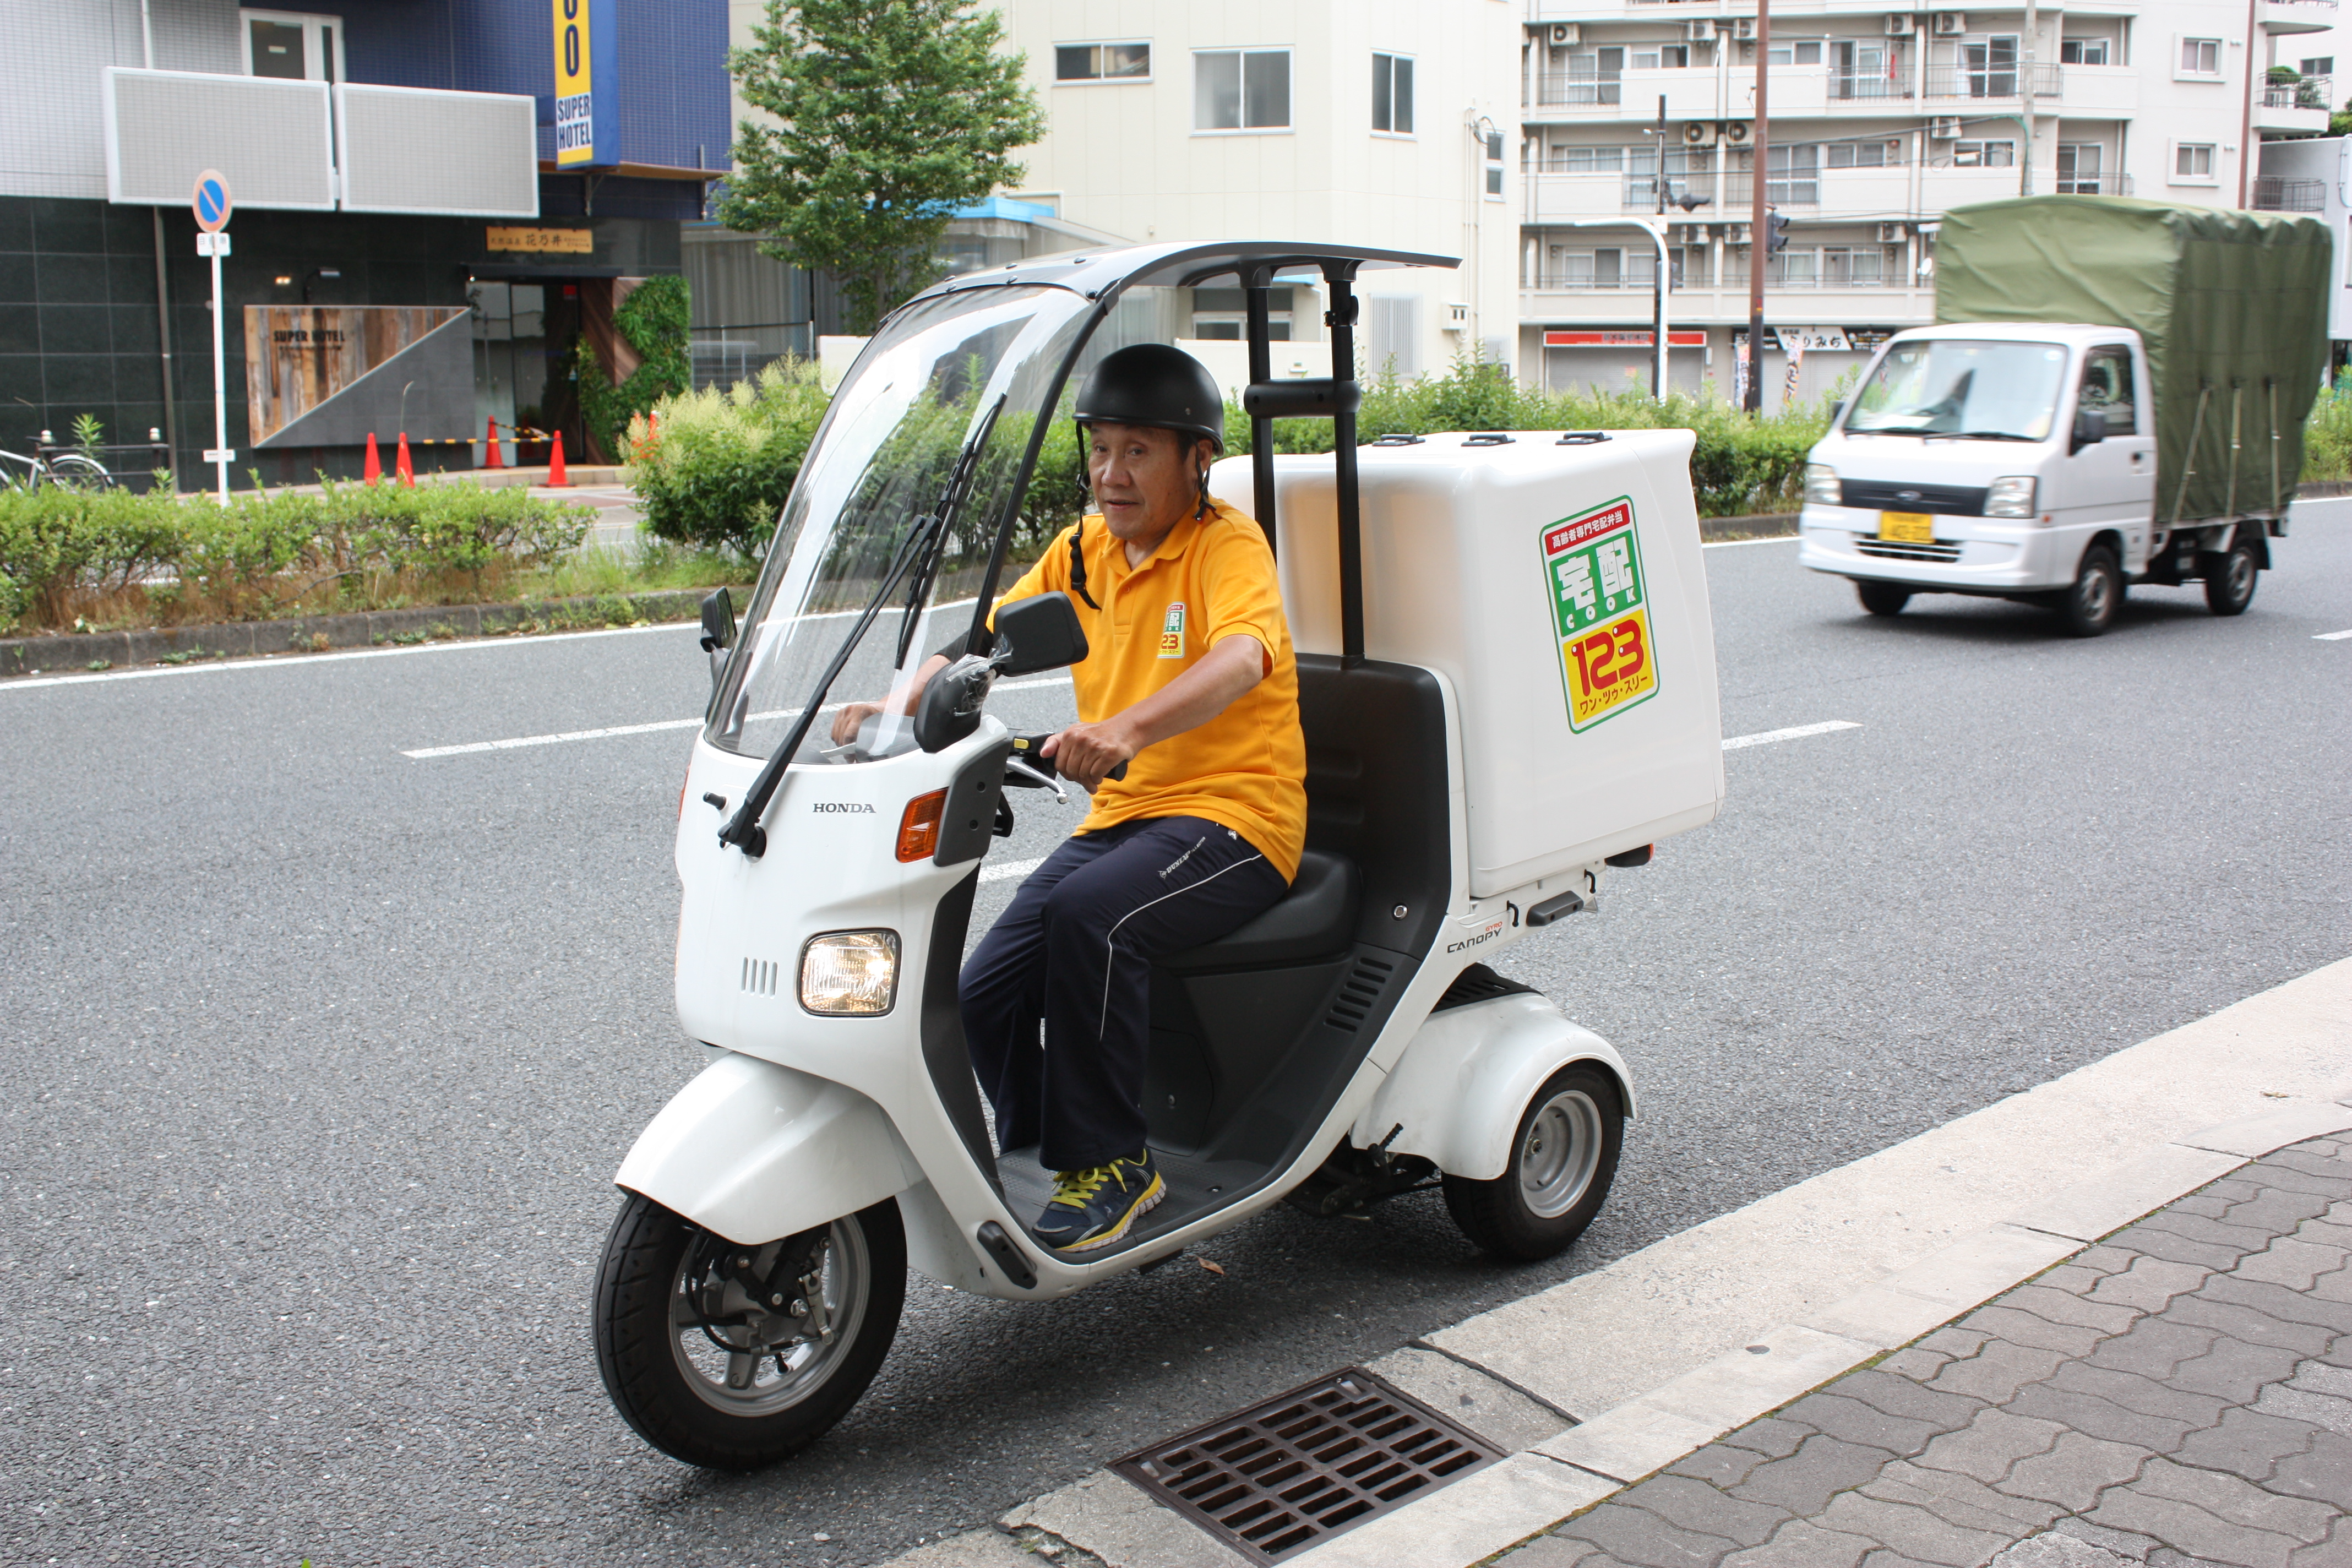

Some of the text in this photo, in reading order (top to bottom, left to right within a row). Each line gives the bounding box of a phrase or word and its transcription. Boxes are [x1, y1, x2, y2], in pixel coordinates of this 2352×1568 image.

[558, 95, 590, 121] SUPER
[558, 122, 590, 149] HOTEL
[274, 330, 345, 342] SUPER HOTEL
[1552, 510, 1623, 548] 高齢者専門宅配弁当
[1556, 537, 1634, 611] 宅配
[1566, 587, 1636, 629] COOK
[1571, 619, 1645, 697] 123
[813, 803, 876, 813] HONDA
[1485, 921, 1503, 932] GYRO
[1447, 928, 1502, 954] CANOPY
